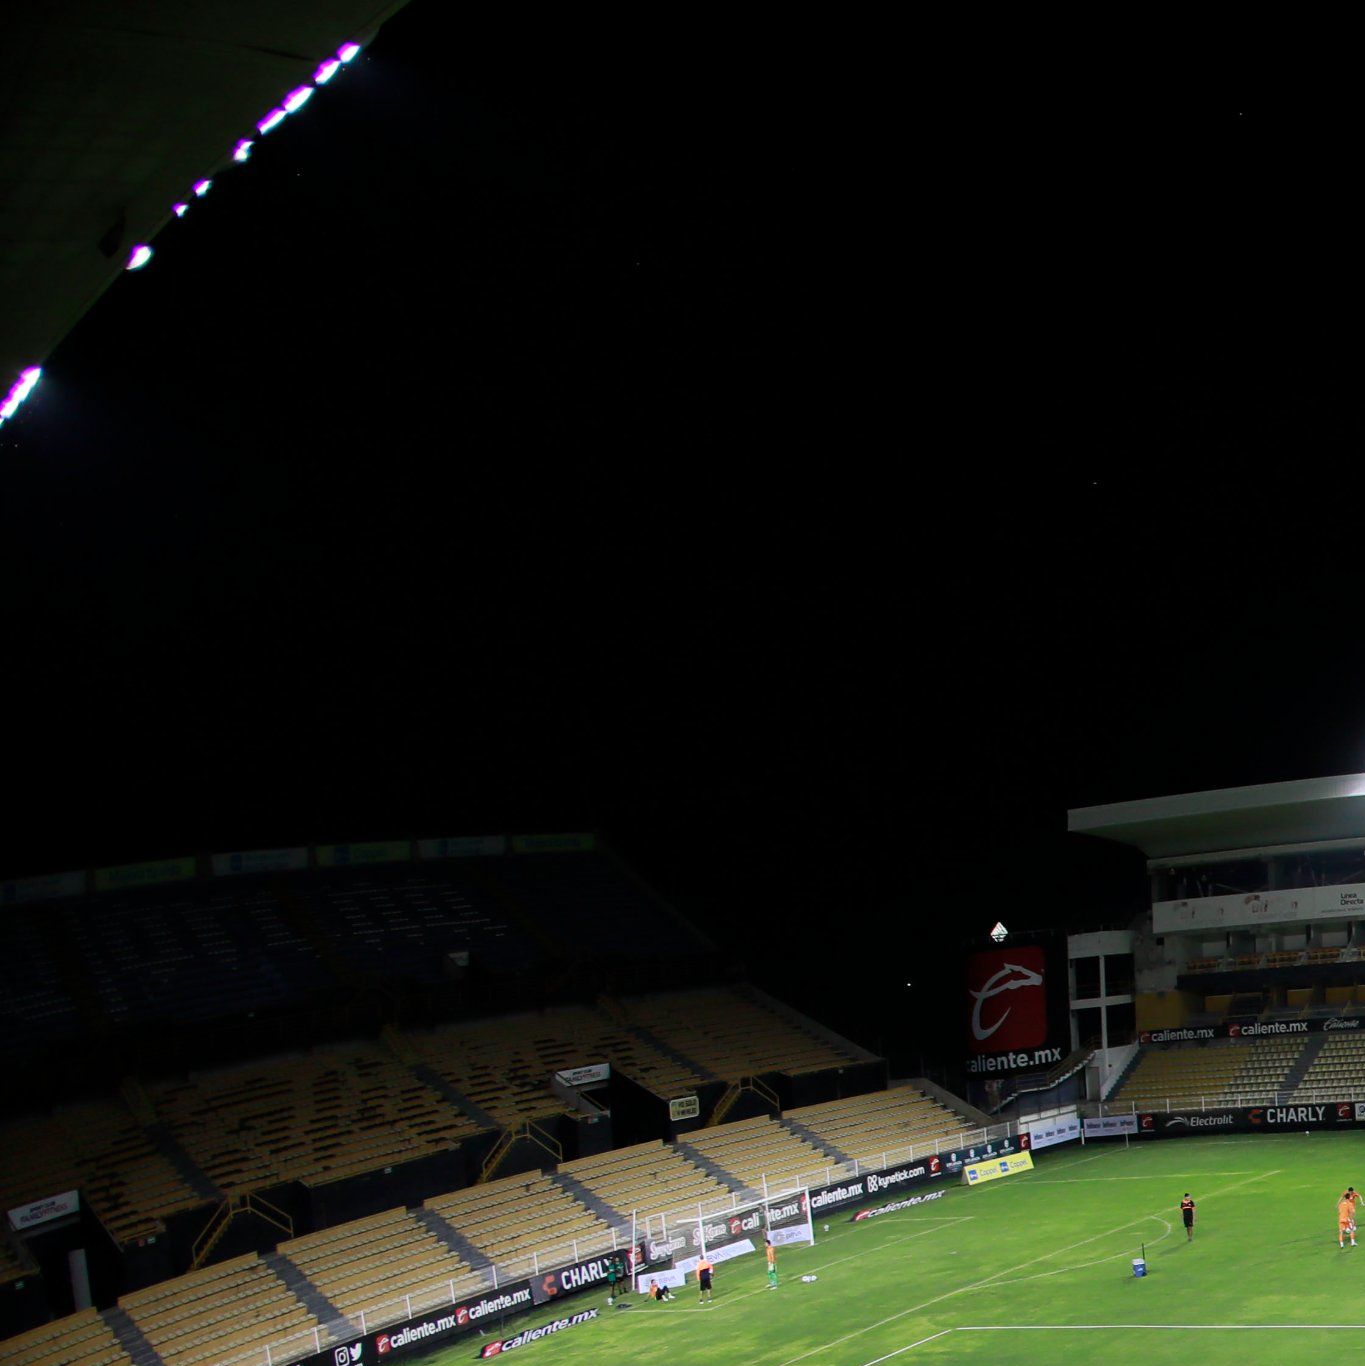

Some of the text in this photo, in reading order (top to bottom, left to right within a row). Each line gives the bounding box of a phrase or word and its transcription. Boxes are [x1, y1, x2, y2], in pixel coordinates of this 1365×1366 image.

[1152, 1028, 1214, 1042] caliente.mx
[1241, 1021, 1308, 1036] caliente.mx
[966, 1047, 1062, 1074] caliente.mx
[1190, 1114, 1234, 1127] Electrolit
[1266, 1106, 1326, 1123] CHARLY
[878, 1165, 925, 1187] kynetick.com
[811, 1182, 863, 1208] caliente.mx
[868, 1190, 946, 1217] caliente.mx
[469, 1287, 532, 1319] caliente.mx
[390, 1314, 456, 1349] caliente.mx
[501, 1307, 600, 1351] caliente.mx
